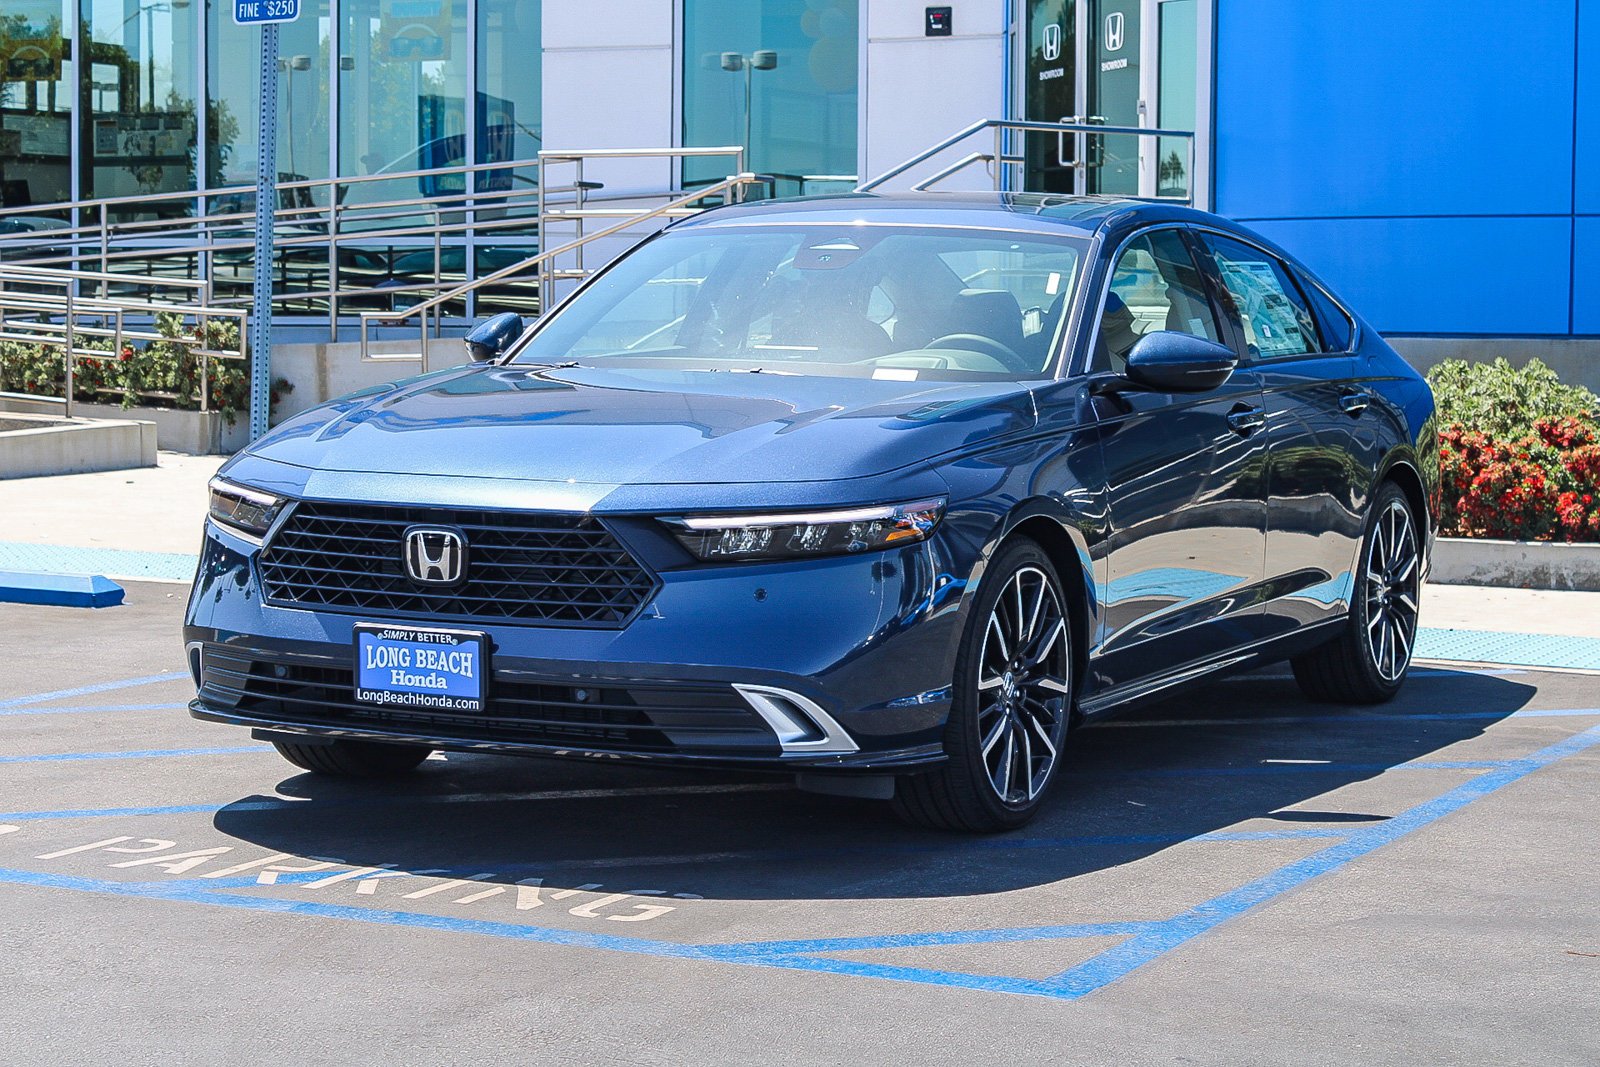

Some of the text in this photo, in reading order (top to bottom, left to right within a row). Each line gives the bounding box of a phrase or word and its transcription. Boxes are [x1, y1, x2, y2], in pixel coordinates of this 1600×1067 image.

[239, 0, 294, 18] FINE $250
[1039, 68, 1064, 80] SHOWROOM
[1101, 58, 1127, 72] SHOWROOM
[383, 629, 452, 644] SIMPLY BETTER
[366, 645, 473, 678] LONG BEACH
[390, 669, 448, 689] Honda
[357, 688, 480, 710] LongBeachHonda.com
[34, 836, 703, 921] PARKING
